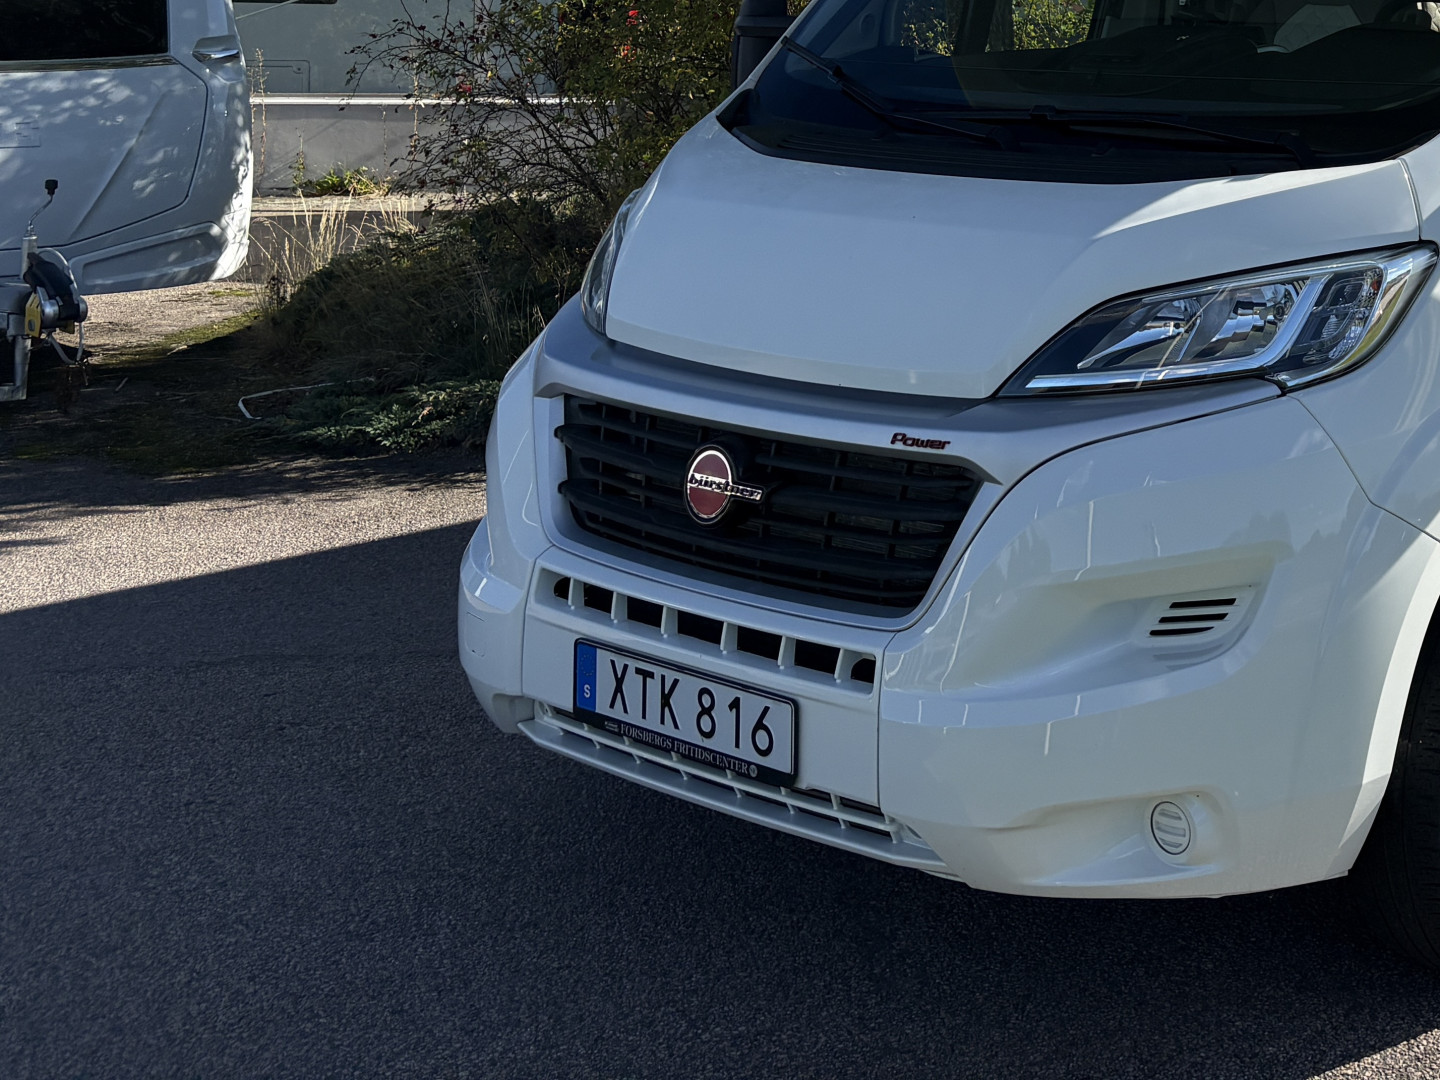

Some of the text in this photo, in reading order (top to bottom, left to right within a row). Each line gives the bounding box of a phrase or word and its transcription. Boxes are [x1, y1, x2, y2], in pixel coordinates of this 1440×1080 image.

[890, 432, 951, 450] Power
[583, 684, 591, 698] S
[609, 658, 774, 757] XTK 816
[619, 723, 672, 750] FORSBERGS
[673, 738, 748, 775] FRITIDSCENTER
